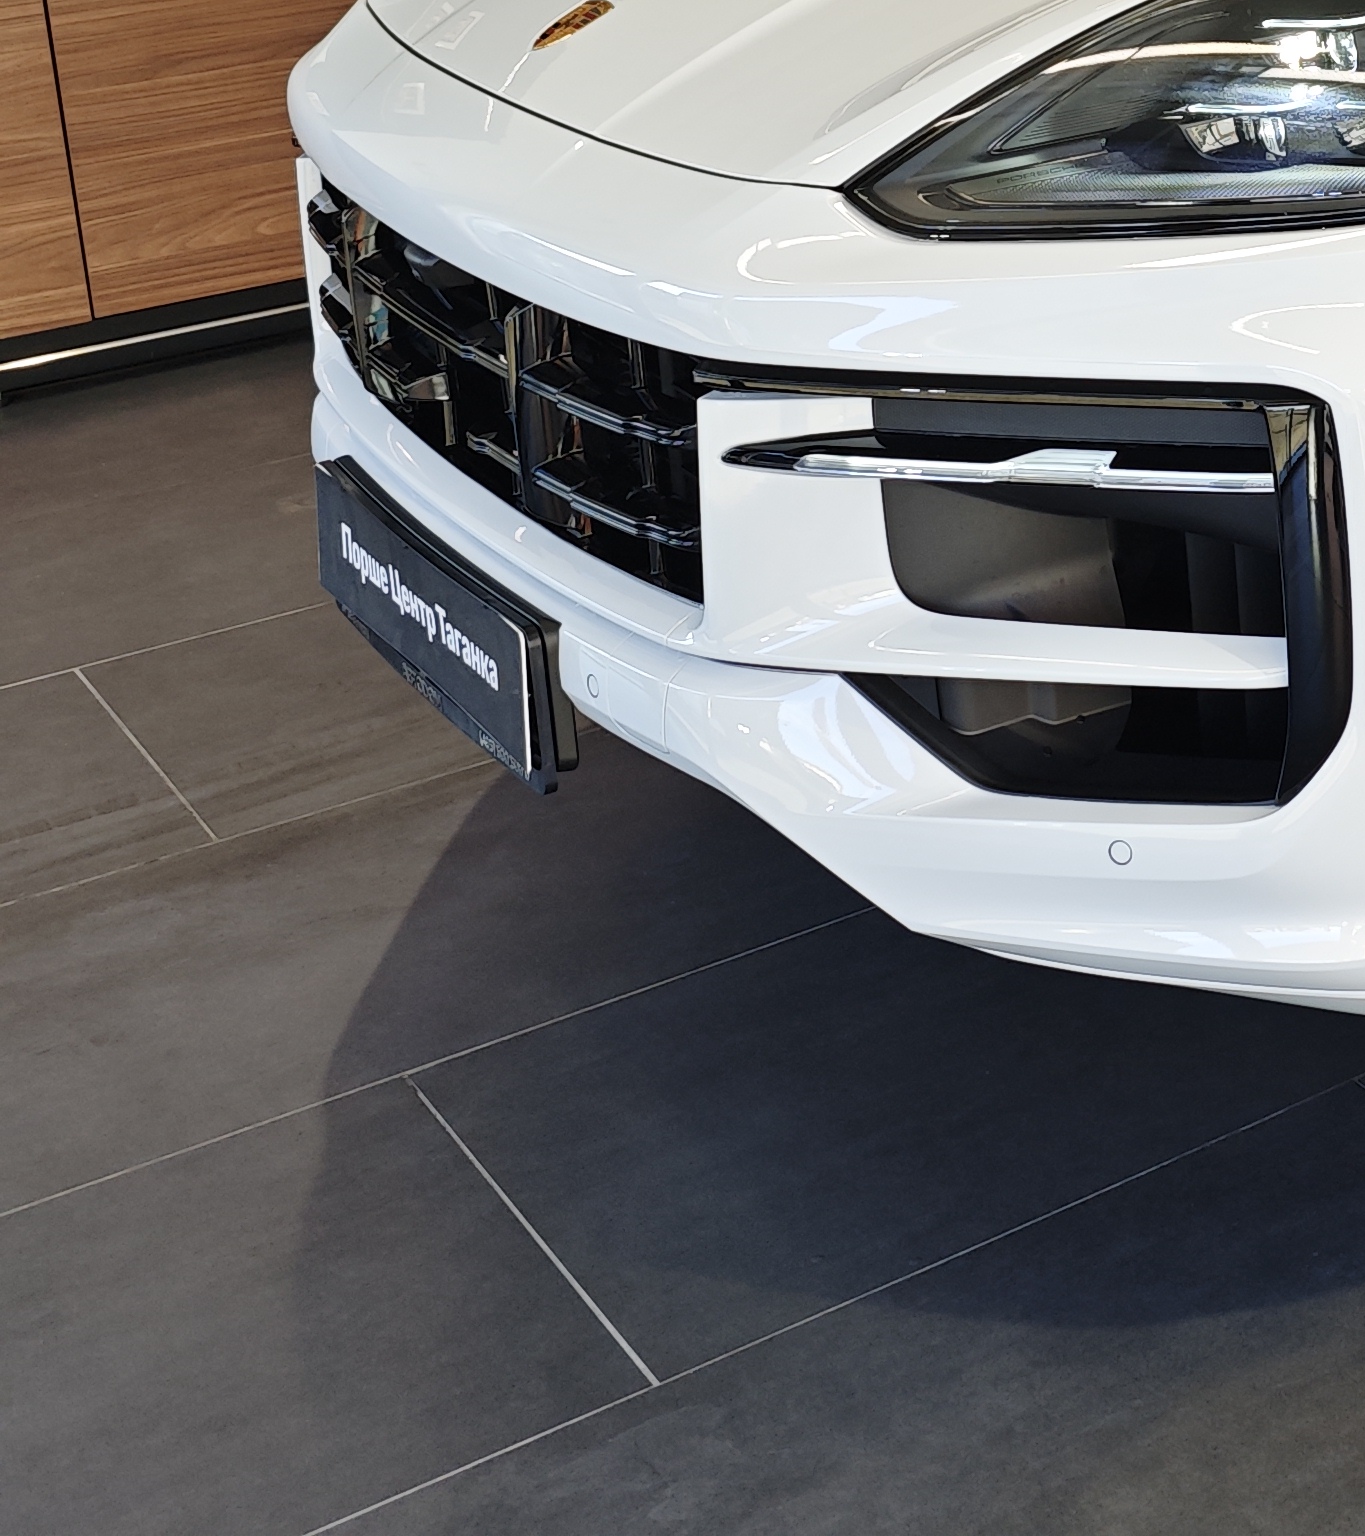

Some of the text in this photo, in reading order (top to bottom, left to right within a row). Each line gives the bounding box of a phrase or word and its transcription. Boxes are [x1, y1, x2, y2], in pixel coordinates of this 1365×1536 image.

[340, 521, 390, 595] Порше
[387, 563, 437, 643] Центр
[434, 602, 500, 692] Таганка
